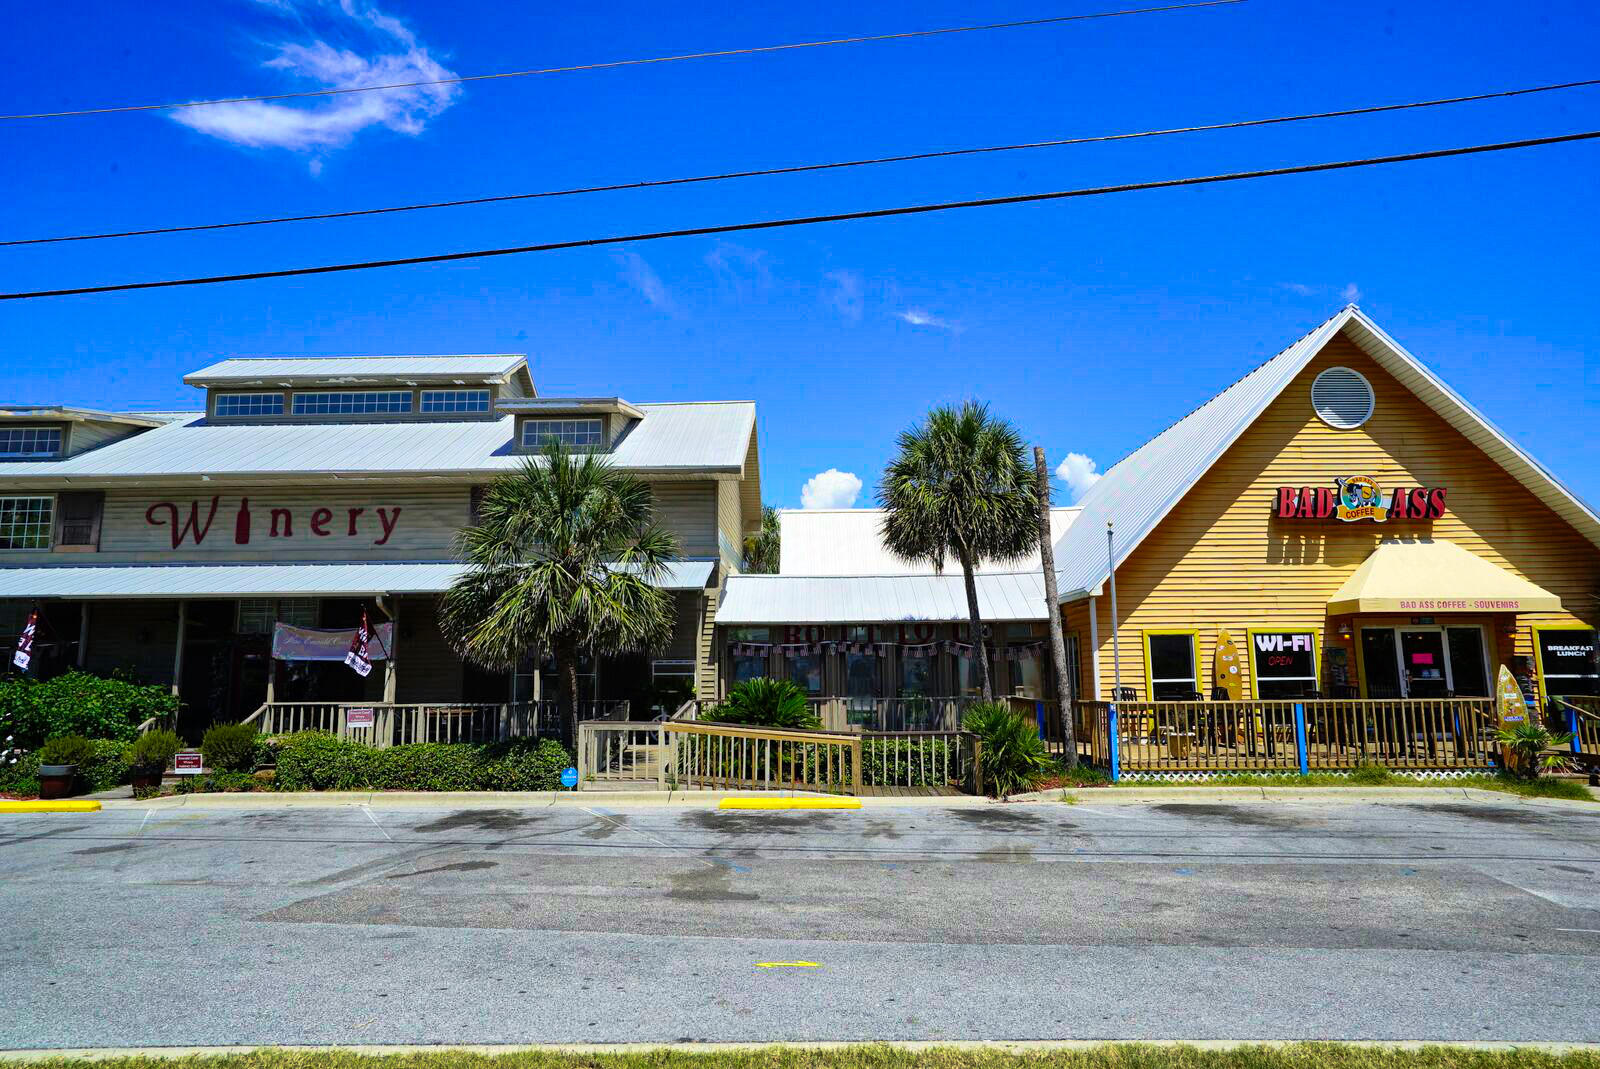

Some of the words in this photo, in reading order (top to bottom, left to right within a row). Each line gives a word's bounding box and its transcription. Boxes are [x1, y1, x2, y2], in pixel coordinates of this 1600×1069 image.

[1277, 487, 1334, 519] BAD
[1391, 487, 1447, 519] ASS
[1345, 507, 1375, 519] COFFEE
[1400, 600, 1416, 609] BAD
[1420, 600, 1434, 609] ASS
[1437, 600, 1467, 609] COFFEE
[1474, 600, 1519, 609] SOUVENIRS
[1255, 634, 1312, 652] WI-FI
[1267, 655, 1294, 666] OPEN
